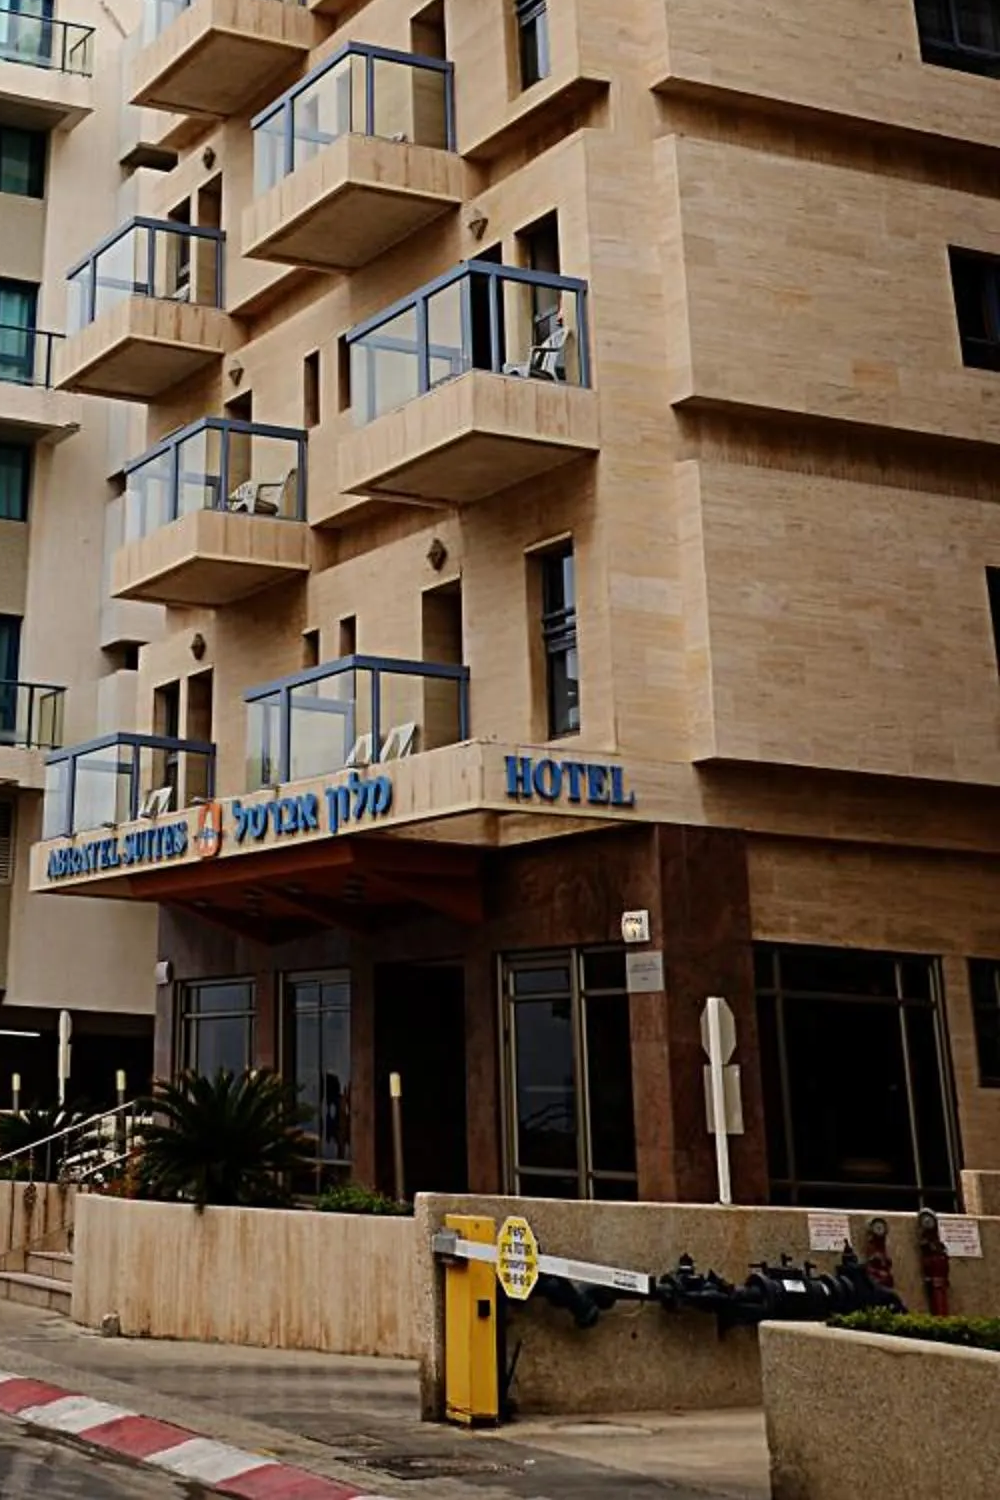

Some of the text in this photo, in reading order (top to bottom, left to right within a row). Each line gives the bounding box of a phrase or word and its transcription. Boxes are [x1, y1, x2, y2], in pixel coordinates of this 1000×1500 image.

[325, 771, 392, 833] מלון
[504, 755, 635, 808] HOTEL
[123, 820, 189, 864] SUITES
